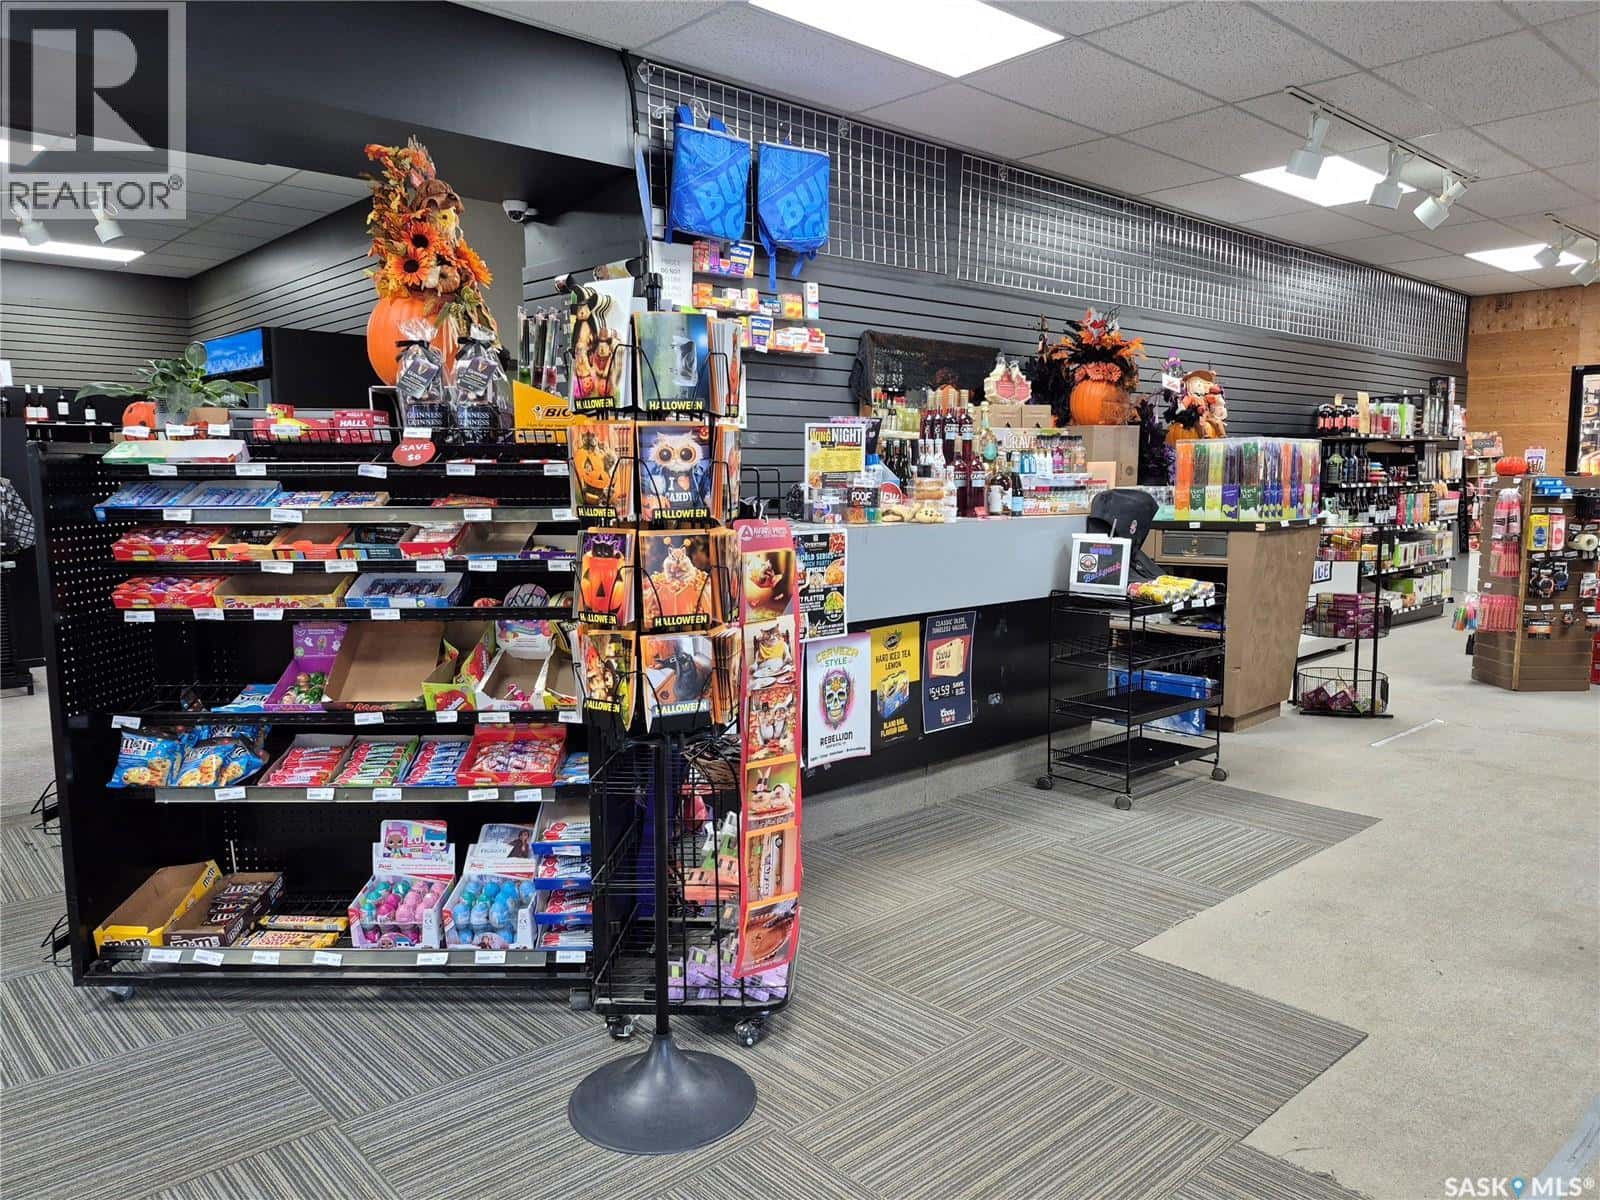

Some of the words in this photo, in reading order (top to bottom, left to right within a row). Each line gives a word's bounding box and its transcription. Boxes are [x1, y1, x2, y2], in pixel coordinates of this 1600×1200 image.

[545, 408, 571, 417] BIC
[832, 427, 861, 444] NIGHT
[668, 477, 676, 490] I
[1314, 563, 1329, 580] ICE
[824, 656, 848, 667] STYLE
[875, 652, 889, 663] HARD
[890, 651, 900, 661] ICED
[901, 649, 911, 659] TEA
[885, 662, 902, 671] LEMON
[820, 731, 853, 746] REBELLION
